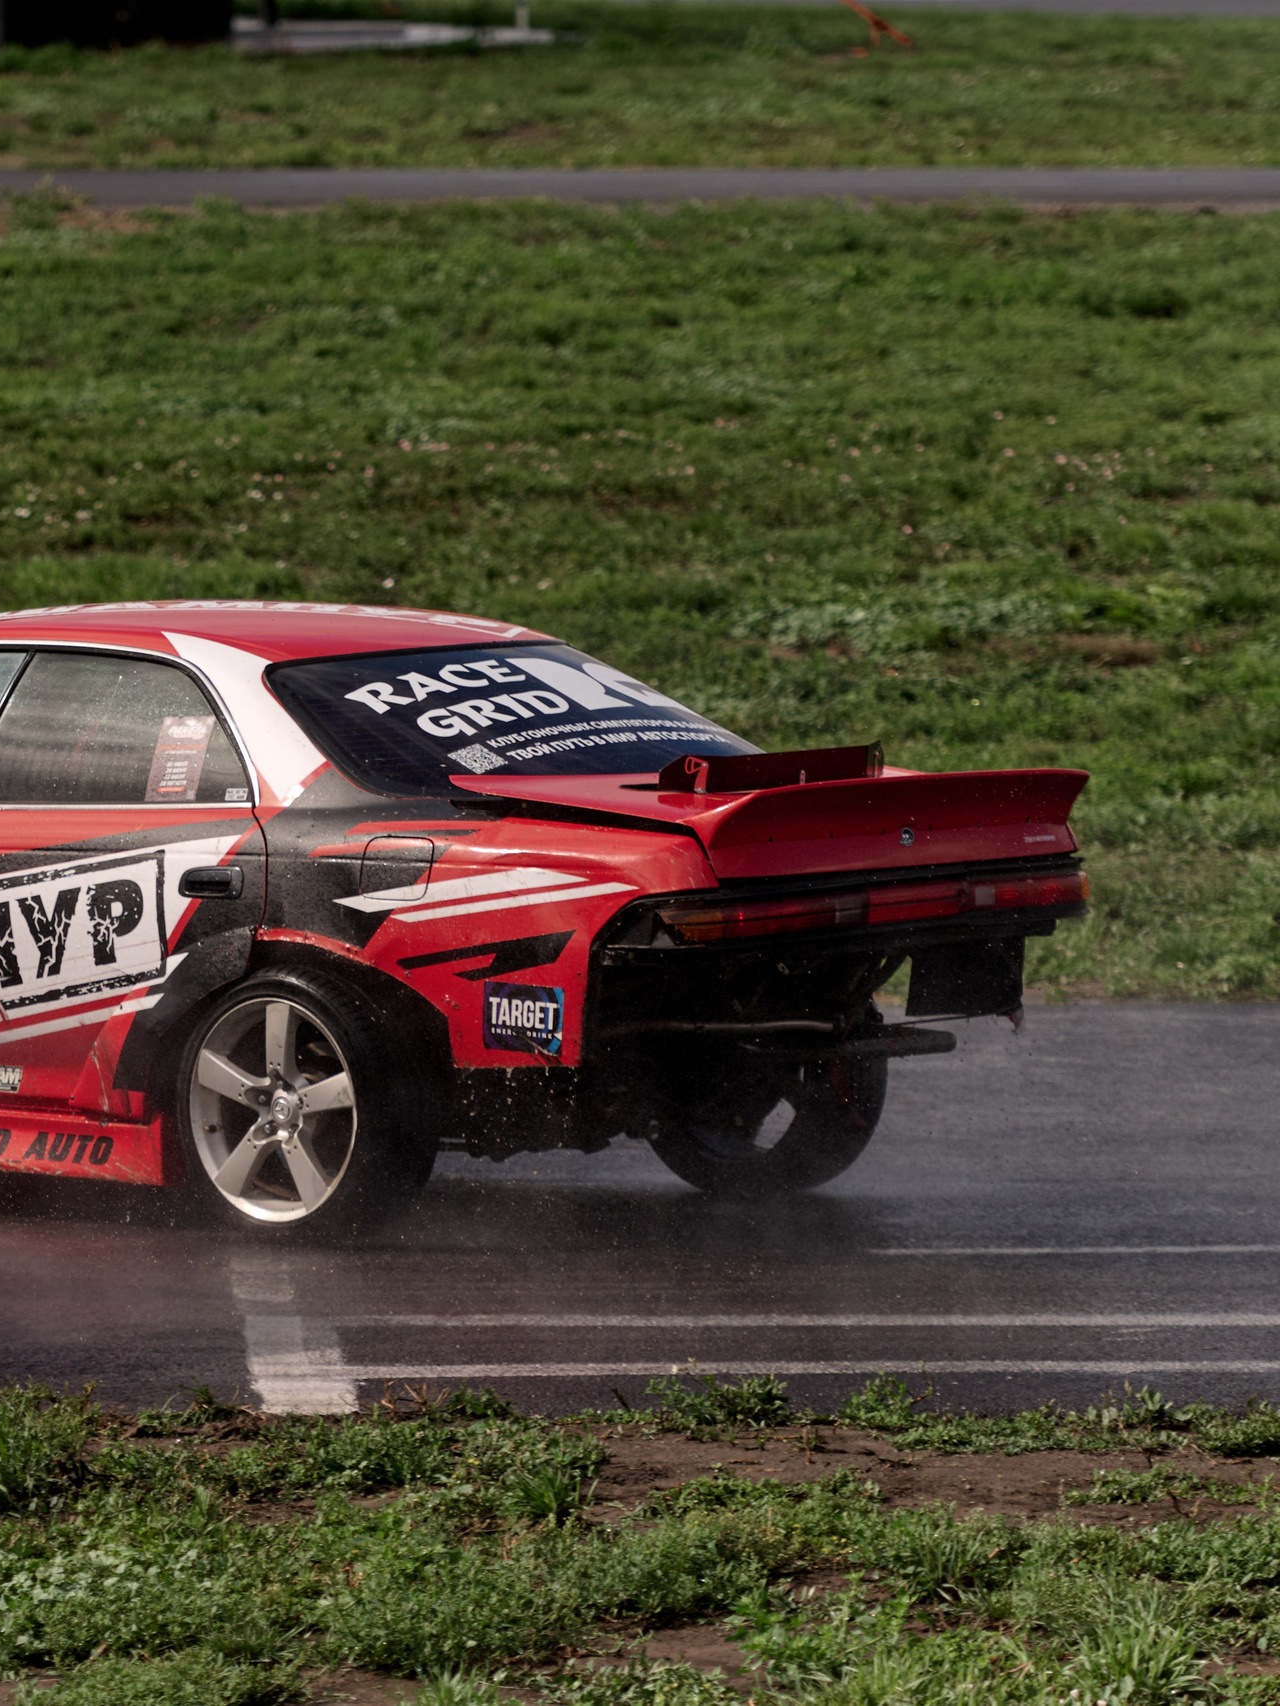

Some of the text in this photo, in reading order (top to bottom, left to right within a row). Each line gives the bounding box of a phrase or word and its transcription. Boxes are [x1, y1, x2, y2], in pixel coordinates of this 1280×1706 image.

[344, 659, 526, 715] RACE
[486, 731, 527, 749] КЛУБ
[521, 722, 595, 740] ГОНОЧНЫХ
[505, 731, 732, 762] ТВОЙ ПУТЬ В МИР АВТОСПОРТА
[488, 996, 560, 1031] TARGET
[491, 1027, 553, 1039] ENERG DRINK
